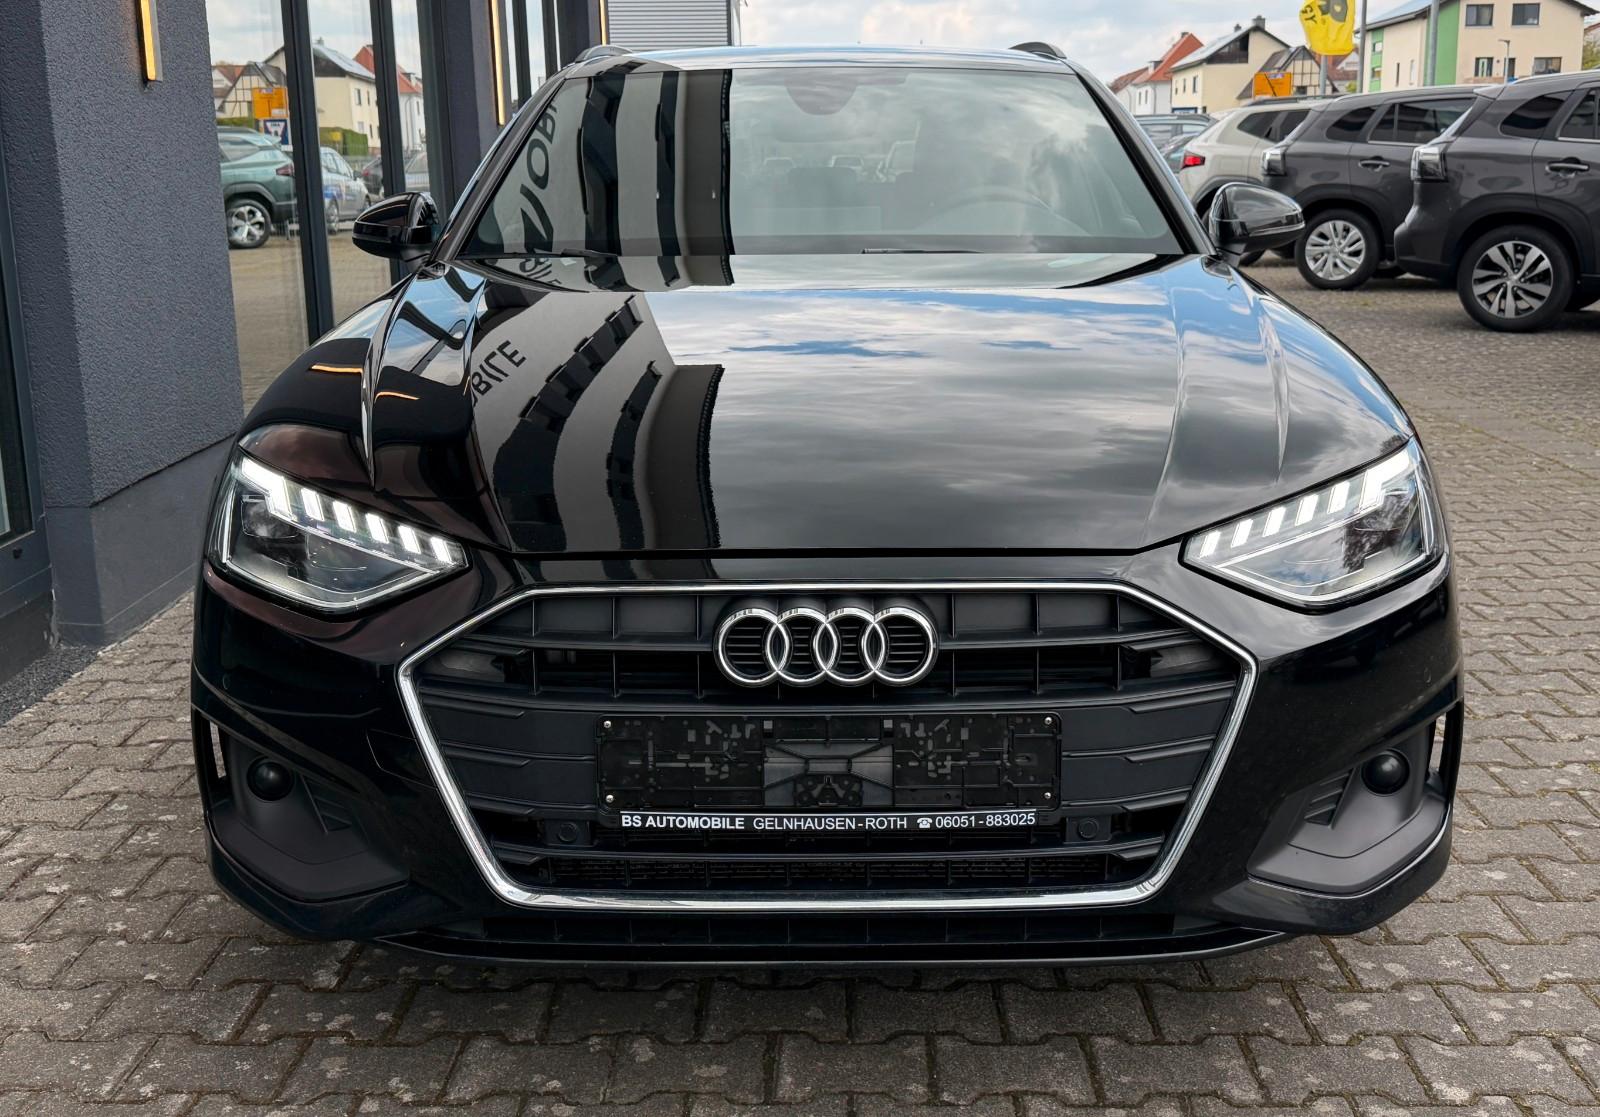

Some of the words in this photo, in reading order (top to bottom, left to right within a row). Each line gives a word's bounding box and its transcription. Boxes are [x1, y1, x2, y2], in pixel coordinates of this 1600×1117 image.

[621, 815, 642, 827] BS
[645, 816, 745, 829] AUTOMOBILE
[753, 817, 907, 830] GELNHAUSEN-ROTH
[935, 813, 1036, 828] 06051-883025
